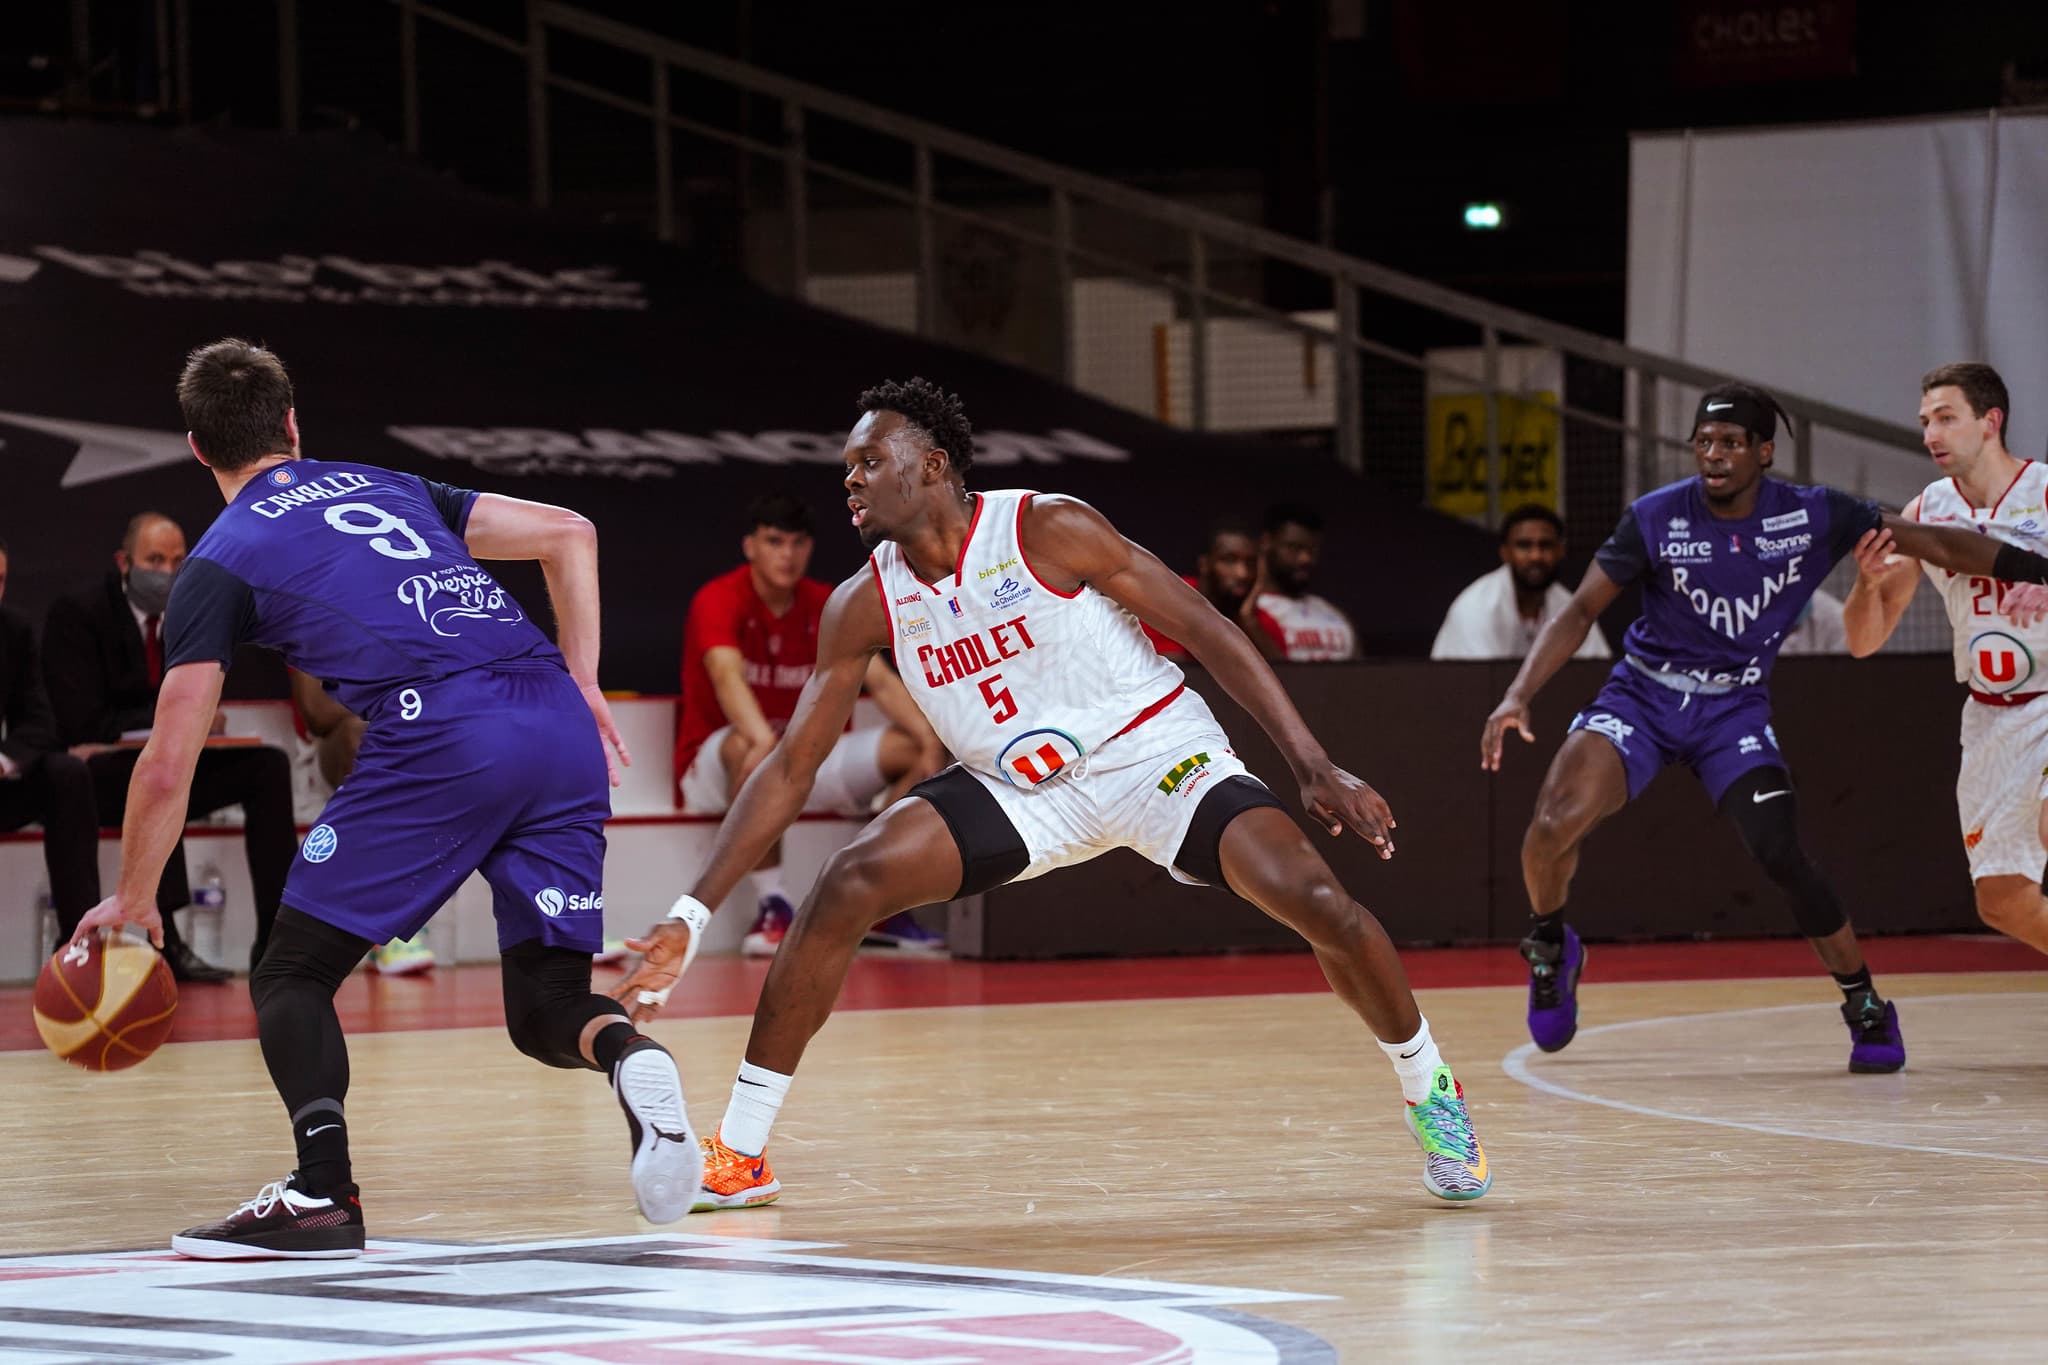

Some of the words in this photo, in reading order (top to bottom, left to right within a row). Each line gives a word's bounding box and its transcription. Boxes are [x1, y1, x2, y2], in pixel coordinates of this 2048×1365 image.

[250, 472, 372, 519] CAVALLO
[323, 502, 431, 560] 9
[1659, 541, 1712, 558] Loire
[978, 557, 1018, 579] bio'bric
[397, 571, 492, 623] Pierre
[895, 591, 922, 606] ALDING
[1672, 555, 1803, 640] ROANNE
[901, 620, 932, 637] LOIRE
[917, 614, 1035, 688] CHOLET
[1979, 650, 2016, 683] U
[399, 688, 423, 721] 9
[977, 673, 1019, 725] 5
[1174, 763, 1206, 793] CLET
